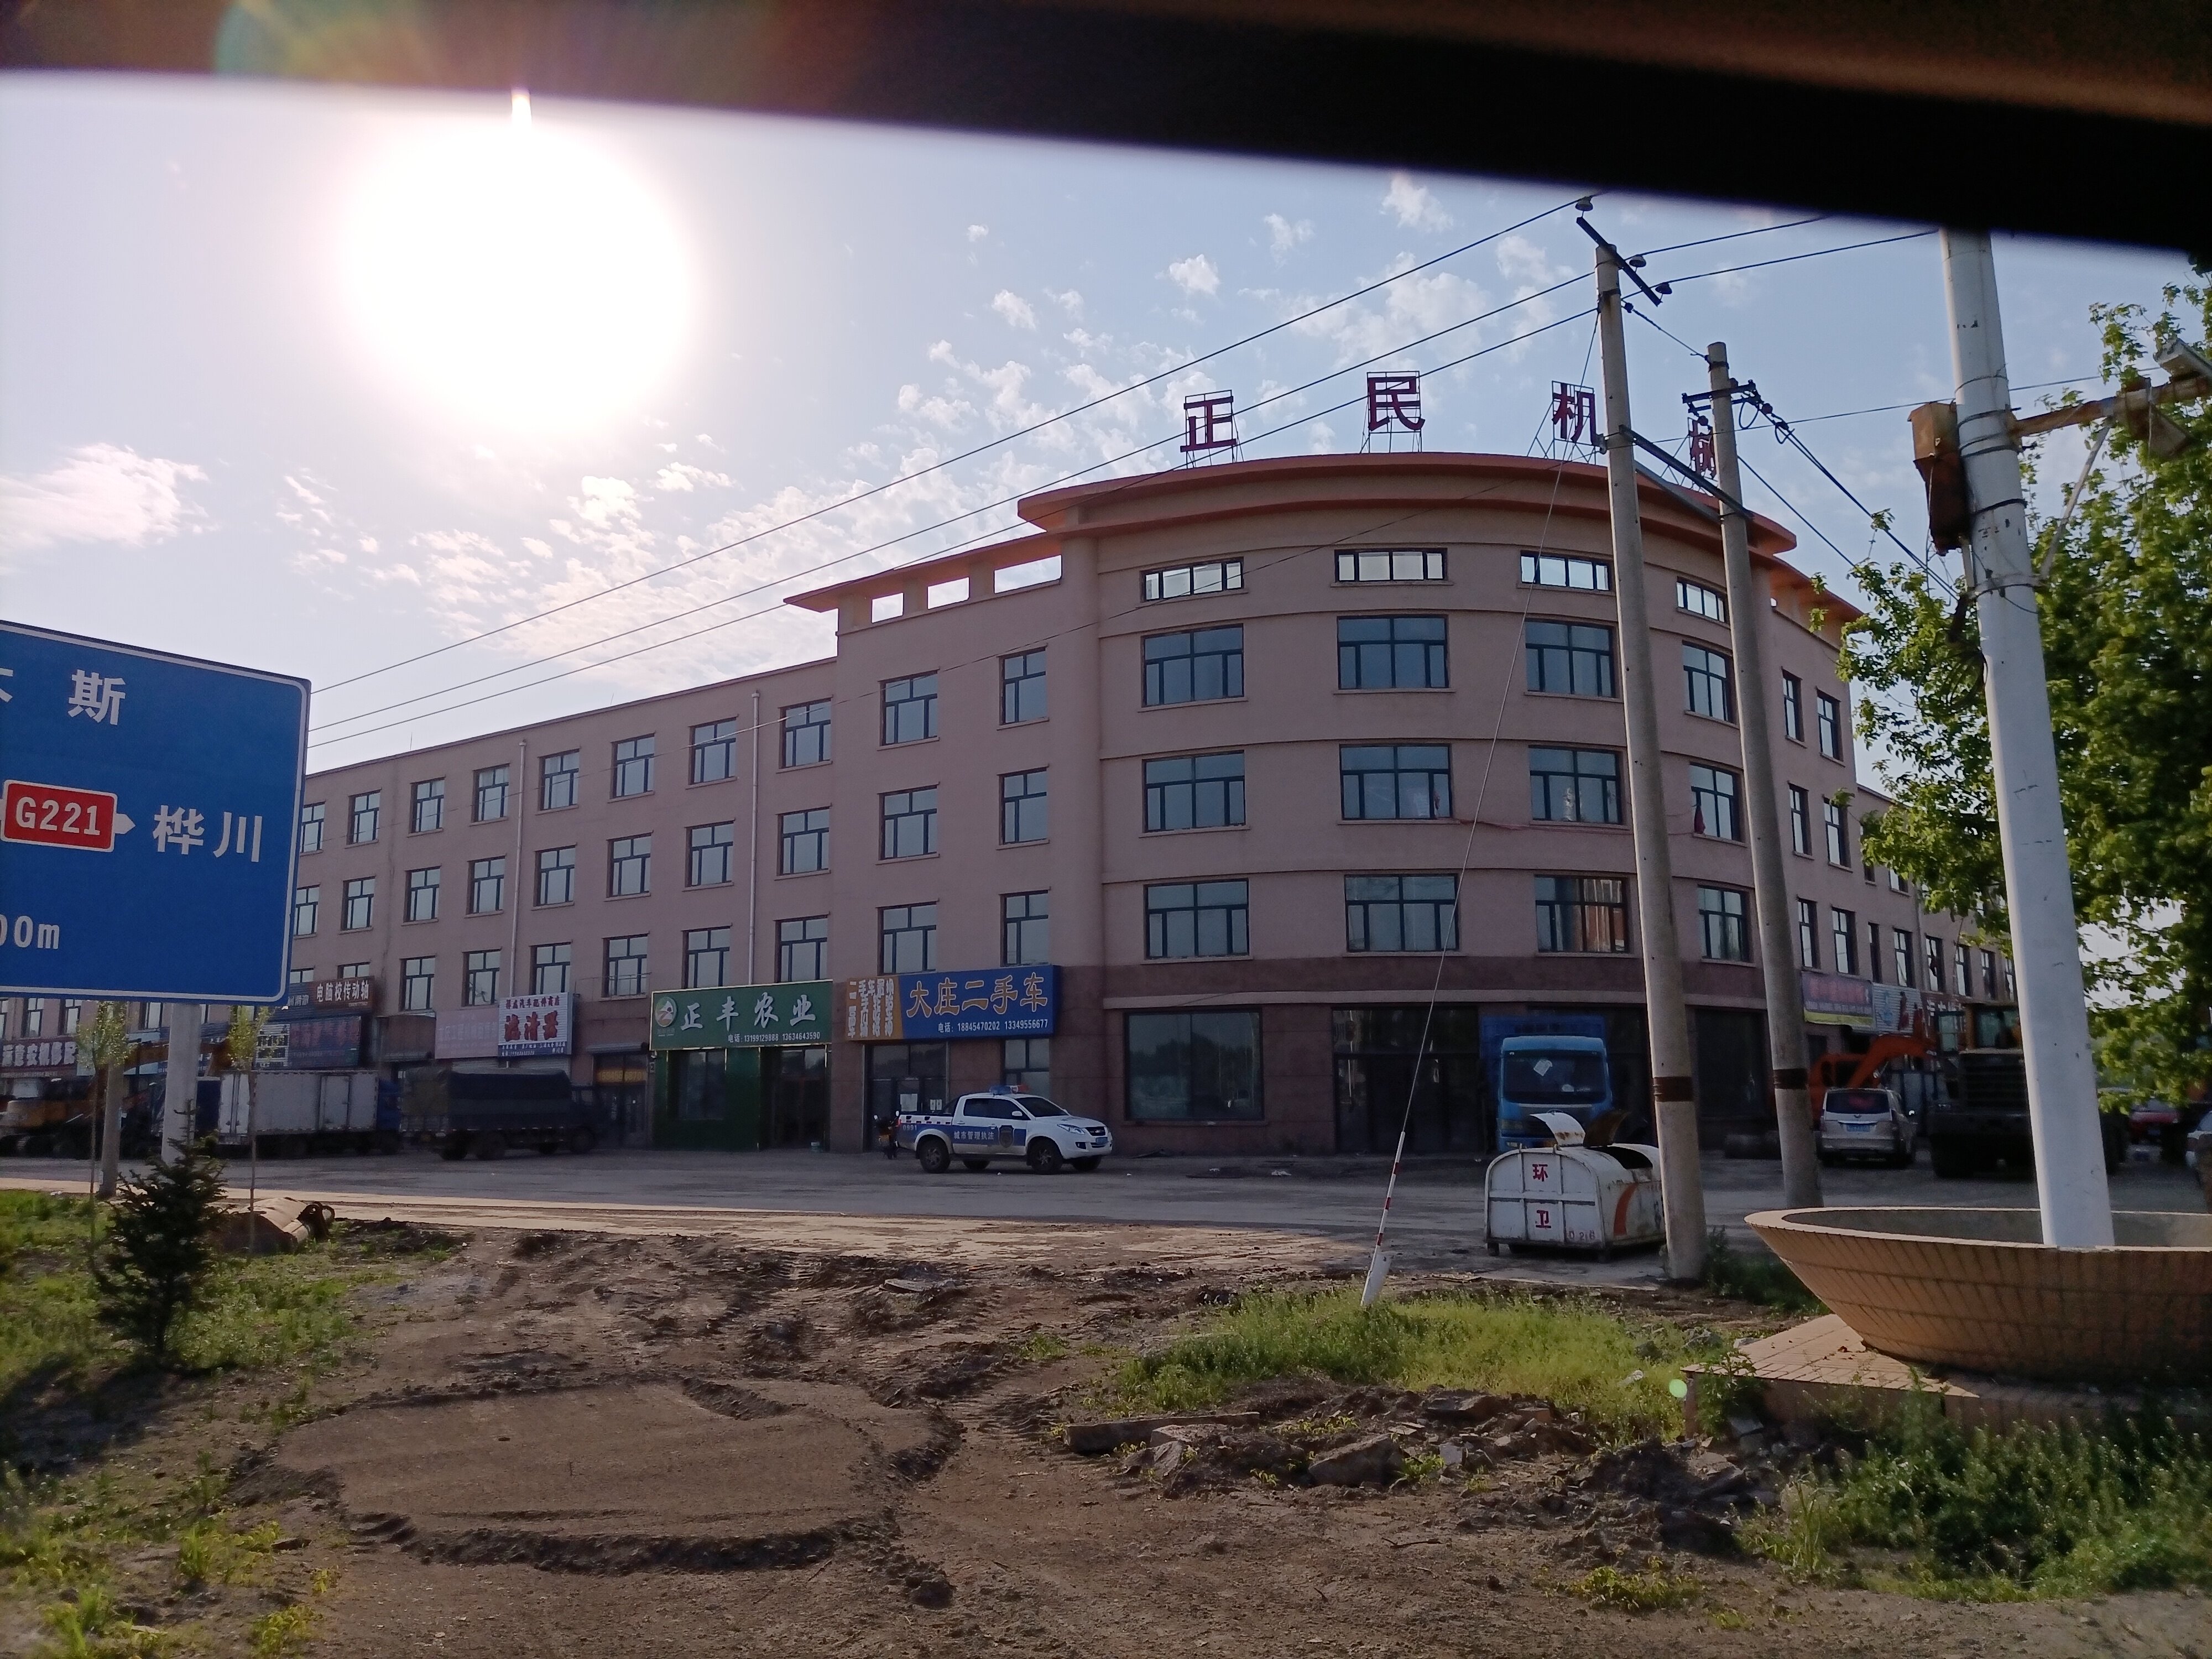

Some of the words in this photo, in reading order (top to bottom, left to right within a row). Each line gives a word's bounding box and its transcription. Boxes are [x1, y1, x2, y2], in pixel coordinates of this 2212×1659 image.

[15, 796, 101, 836] G221
[152, 805, 263, 863] 桦川
[680, 992, 816, 1031] 正丰农业
[906, 972, 1048, 1018] 大庄二手车
[782, 1031, 820, 1041] 13634643590
[957, 1021, 1000, 1032] 18845470202
[1004, 1019, 1048, 1030] 13349556677
[953, 1131, 995, 1140] 城市管理执法
